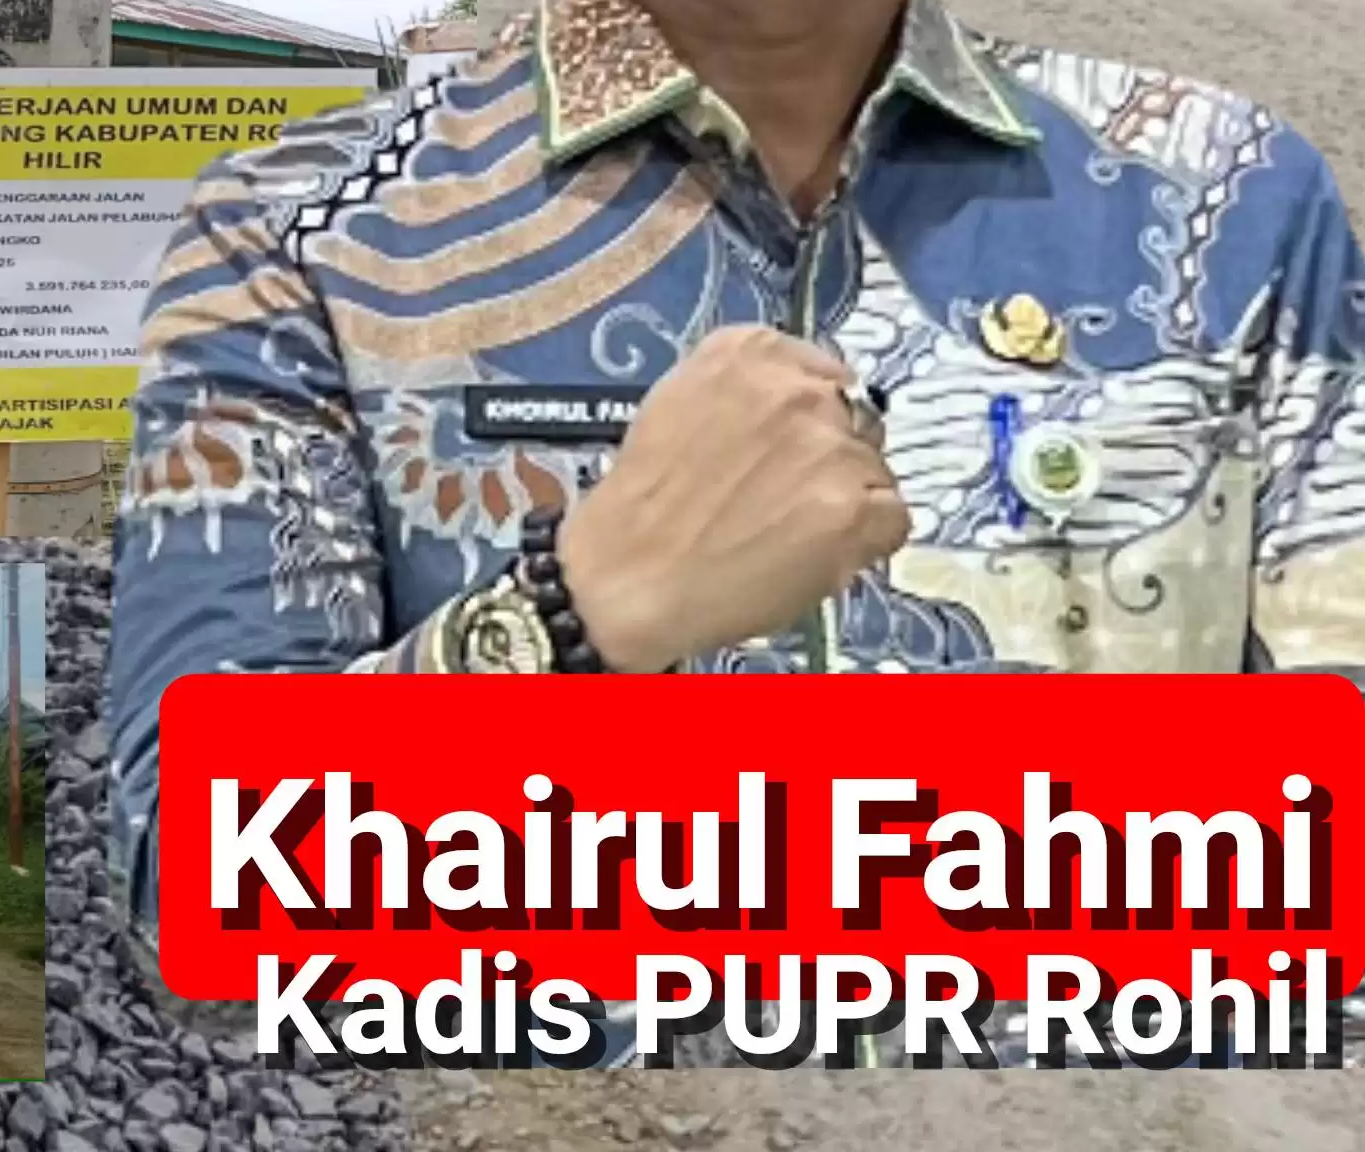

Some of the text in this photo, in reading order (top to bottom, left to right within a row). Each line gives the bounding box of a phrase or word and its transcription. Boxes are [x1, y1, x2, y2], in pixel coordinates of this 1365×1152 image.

[126, 97, 217, 116] UMUM
[226, 97, 287, 115] DAN
[55, 124, 239, 142] KABUPATEN
[23, 151, 102, 169] HILIR
[94, 192, 145, 202] JALAN
[48, 213, 99, 224] JALAN
[0, 305, 73, 315] WIRDANA
[23, 326, 56, 337] NUR
[60, 326, 109, 336] RIANA
